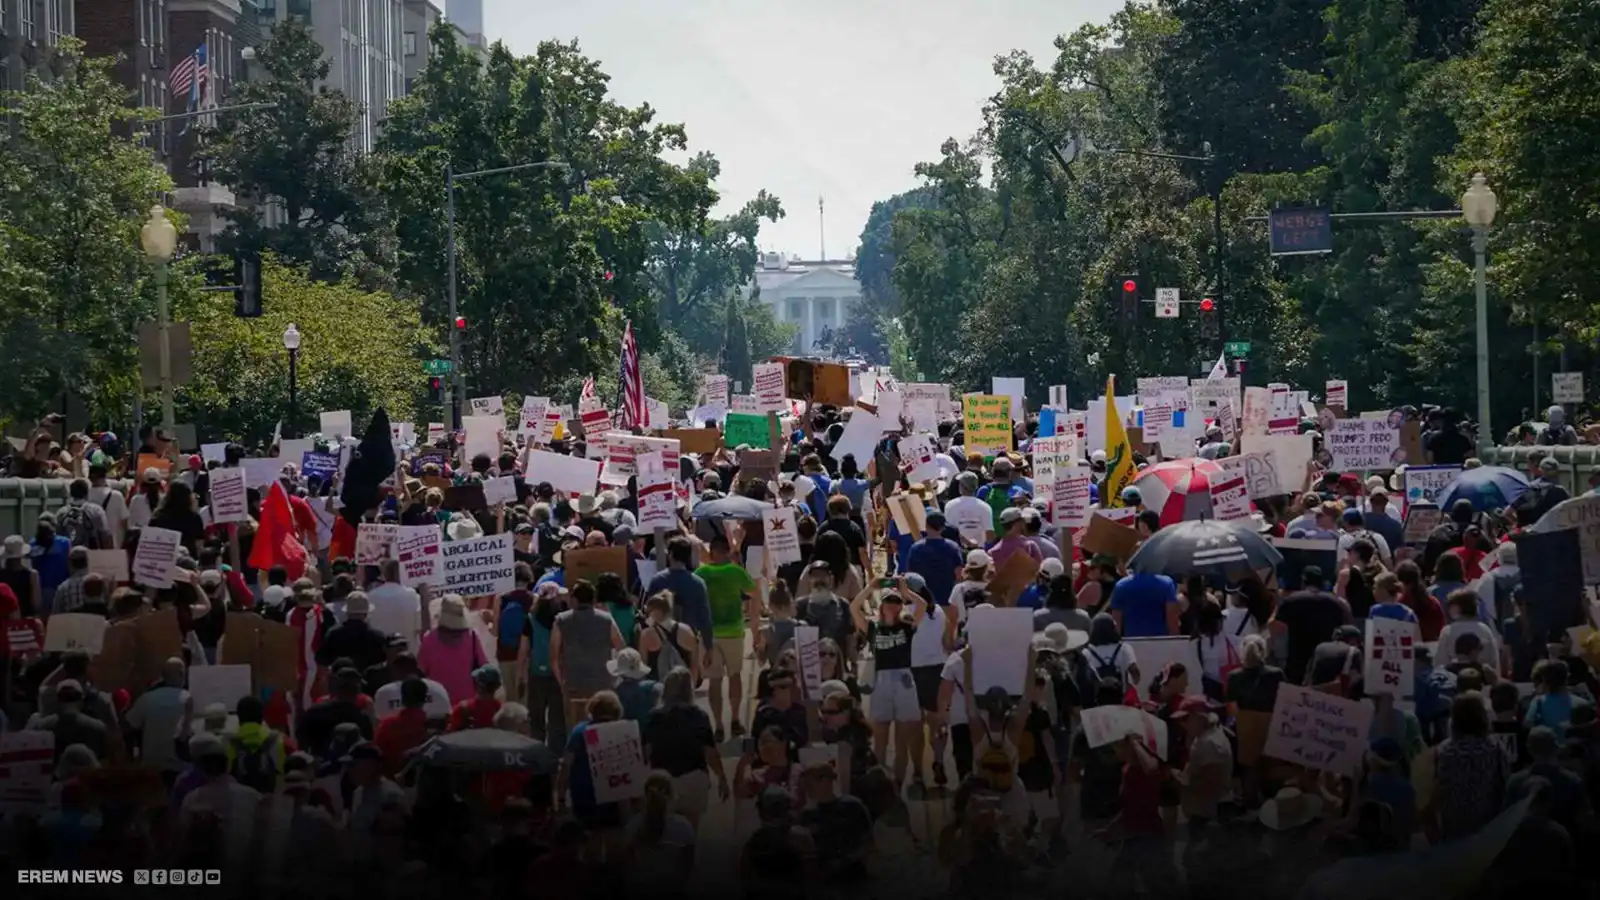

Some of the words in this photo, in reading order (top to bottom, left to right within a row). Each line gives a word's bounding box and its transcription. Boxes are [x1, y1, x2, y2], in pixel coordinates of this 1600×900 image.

[473, 399, 489, 408] END
[1372, 421, 1387, 430] ON
[1330, 434, 1366, 445] TRUMP'S
[1369, 432, 1392, 443] PEDO
[1036, 439, 1074, 453] TRUMP
[1332, 444, 1390, 456] PROTECTION
[1344, 456, 1381, 467] SQUAD
[405, 560, 434, 570] HOME
[408, 568, 433, 579] RULE
[1382, 661, 1403, 673] ALL
[1384, 674, 1400, 686] DC
[1297, 692, 1345, 717] Justice
[503, 752, 527, 766] DC
[607, 773, 632, 788] DC
